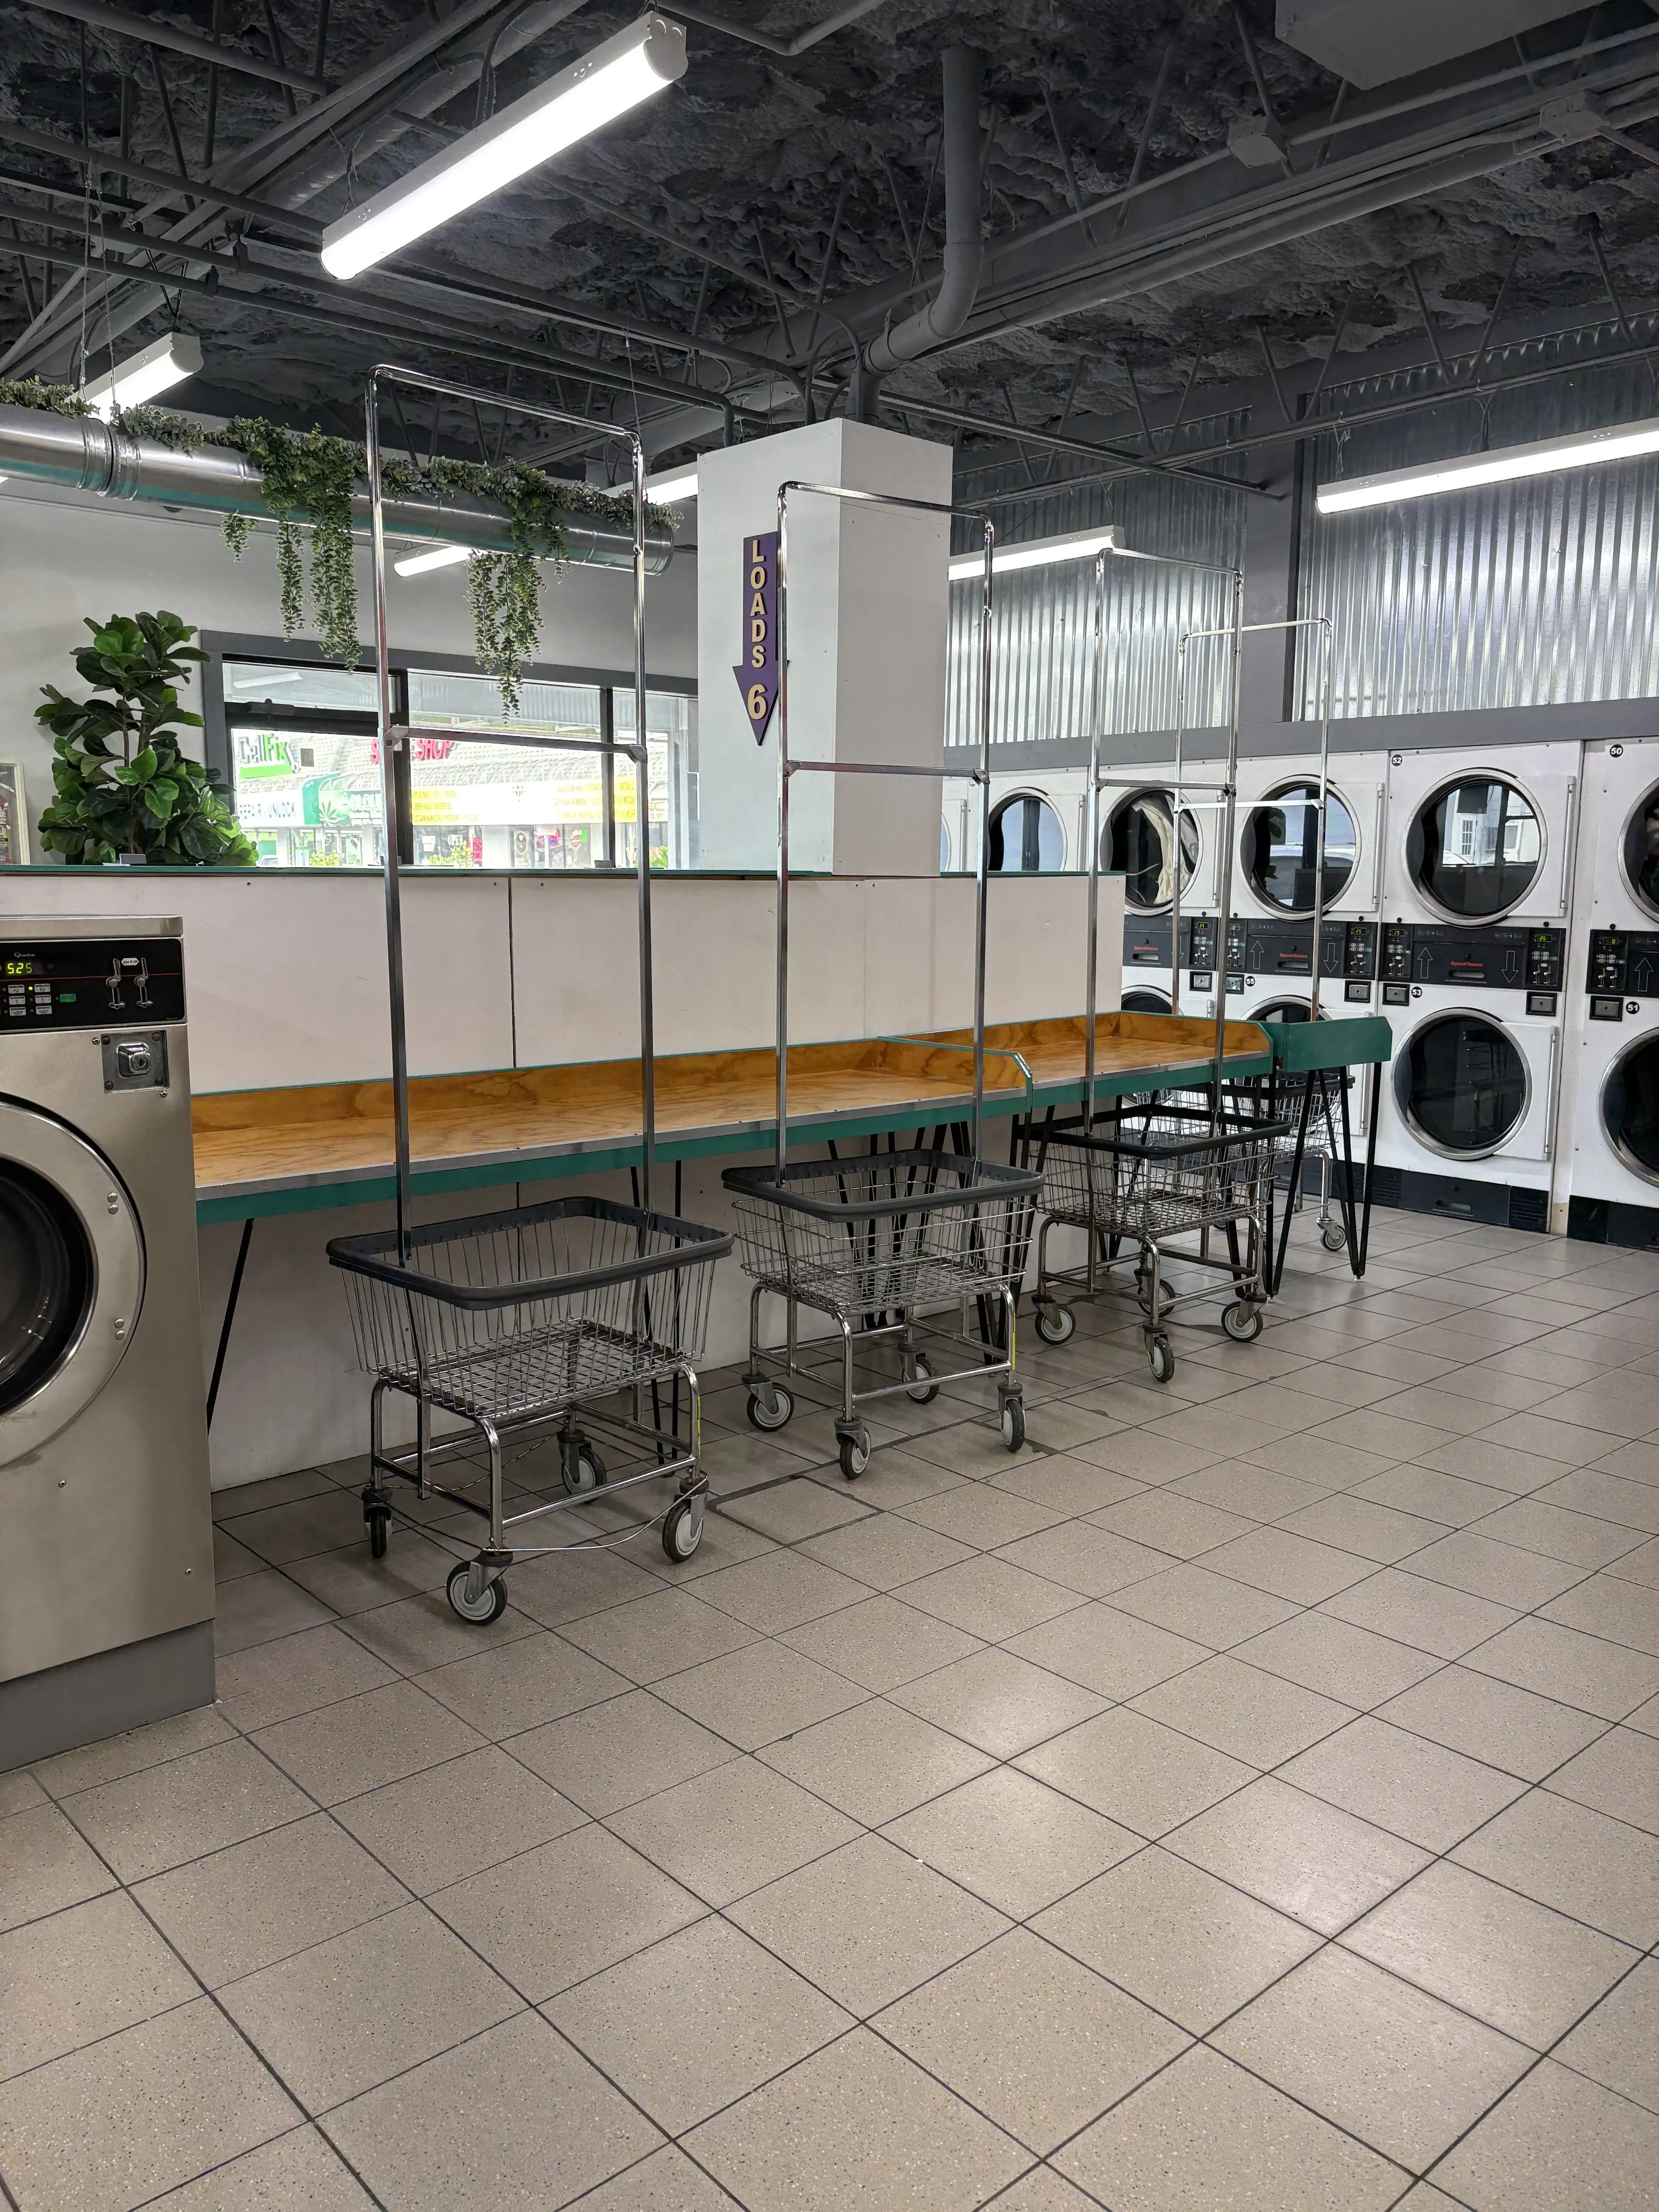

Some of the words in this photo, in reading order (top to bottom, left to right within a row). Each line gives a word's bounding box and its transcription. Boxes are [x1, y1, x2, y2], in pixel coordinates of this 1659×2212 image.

[750, 539, 766, 668] LOADS
[748, 684, 766, 720] 6
[415, 739, 453, 760] SHOP
[268, 801, 296, 818] UNLOCK
